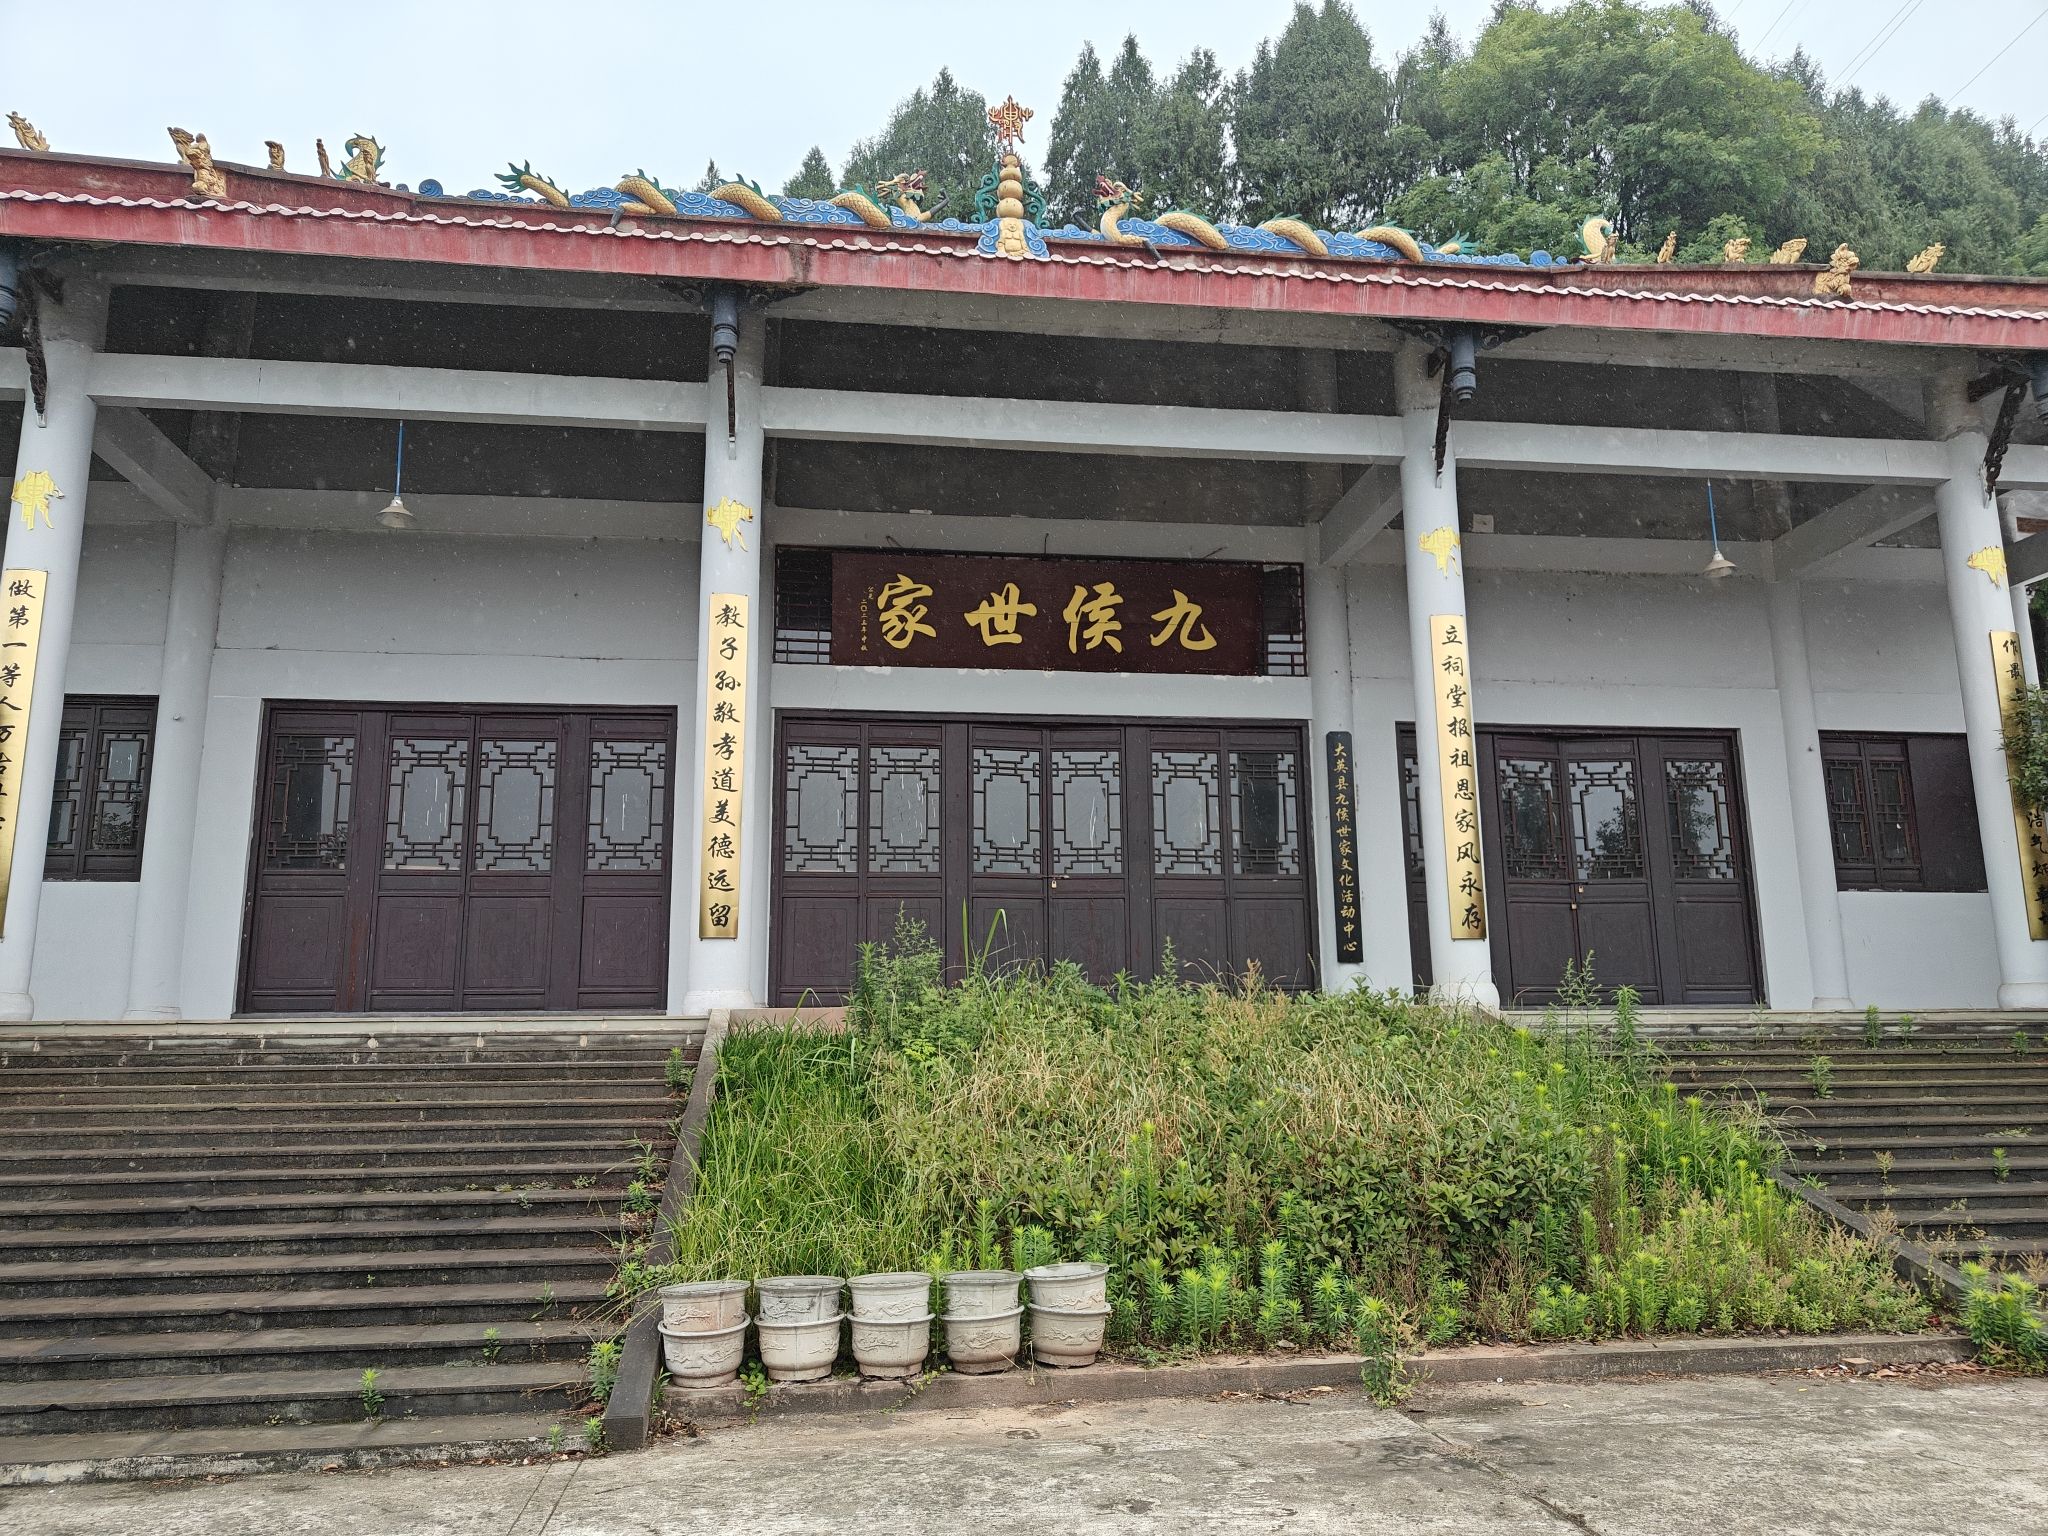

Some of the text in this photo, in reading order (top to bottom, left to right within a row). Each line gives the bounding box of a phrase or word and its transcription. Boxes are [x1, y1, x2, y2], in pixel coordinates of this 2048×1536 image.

[708, 604, 745, 928] 教子孙敬孝道美德远留
[1333, 742, 1357, 952] 大英县九侯世家文化活动中心
[1441, 624, 1482, 931] 立祠堂报祖恩家风永存
